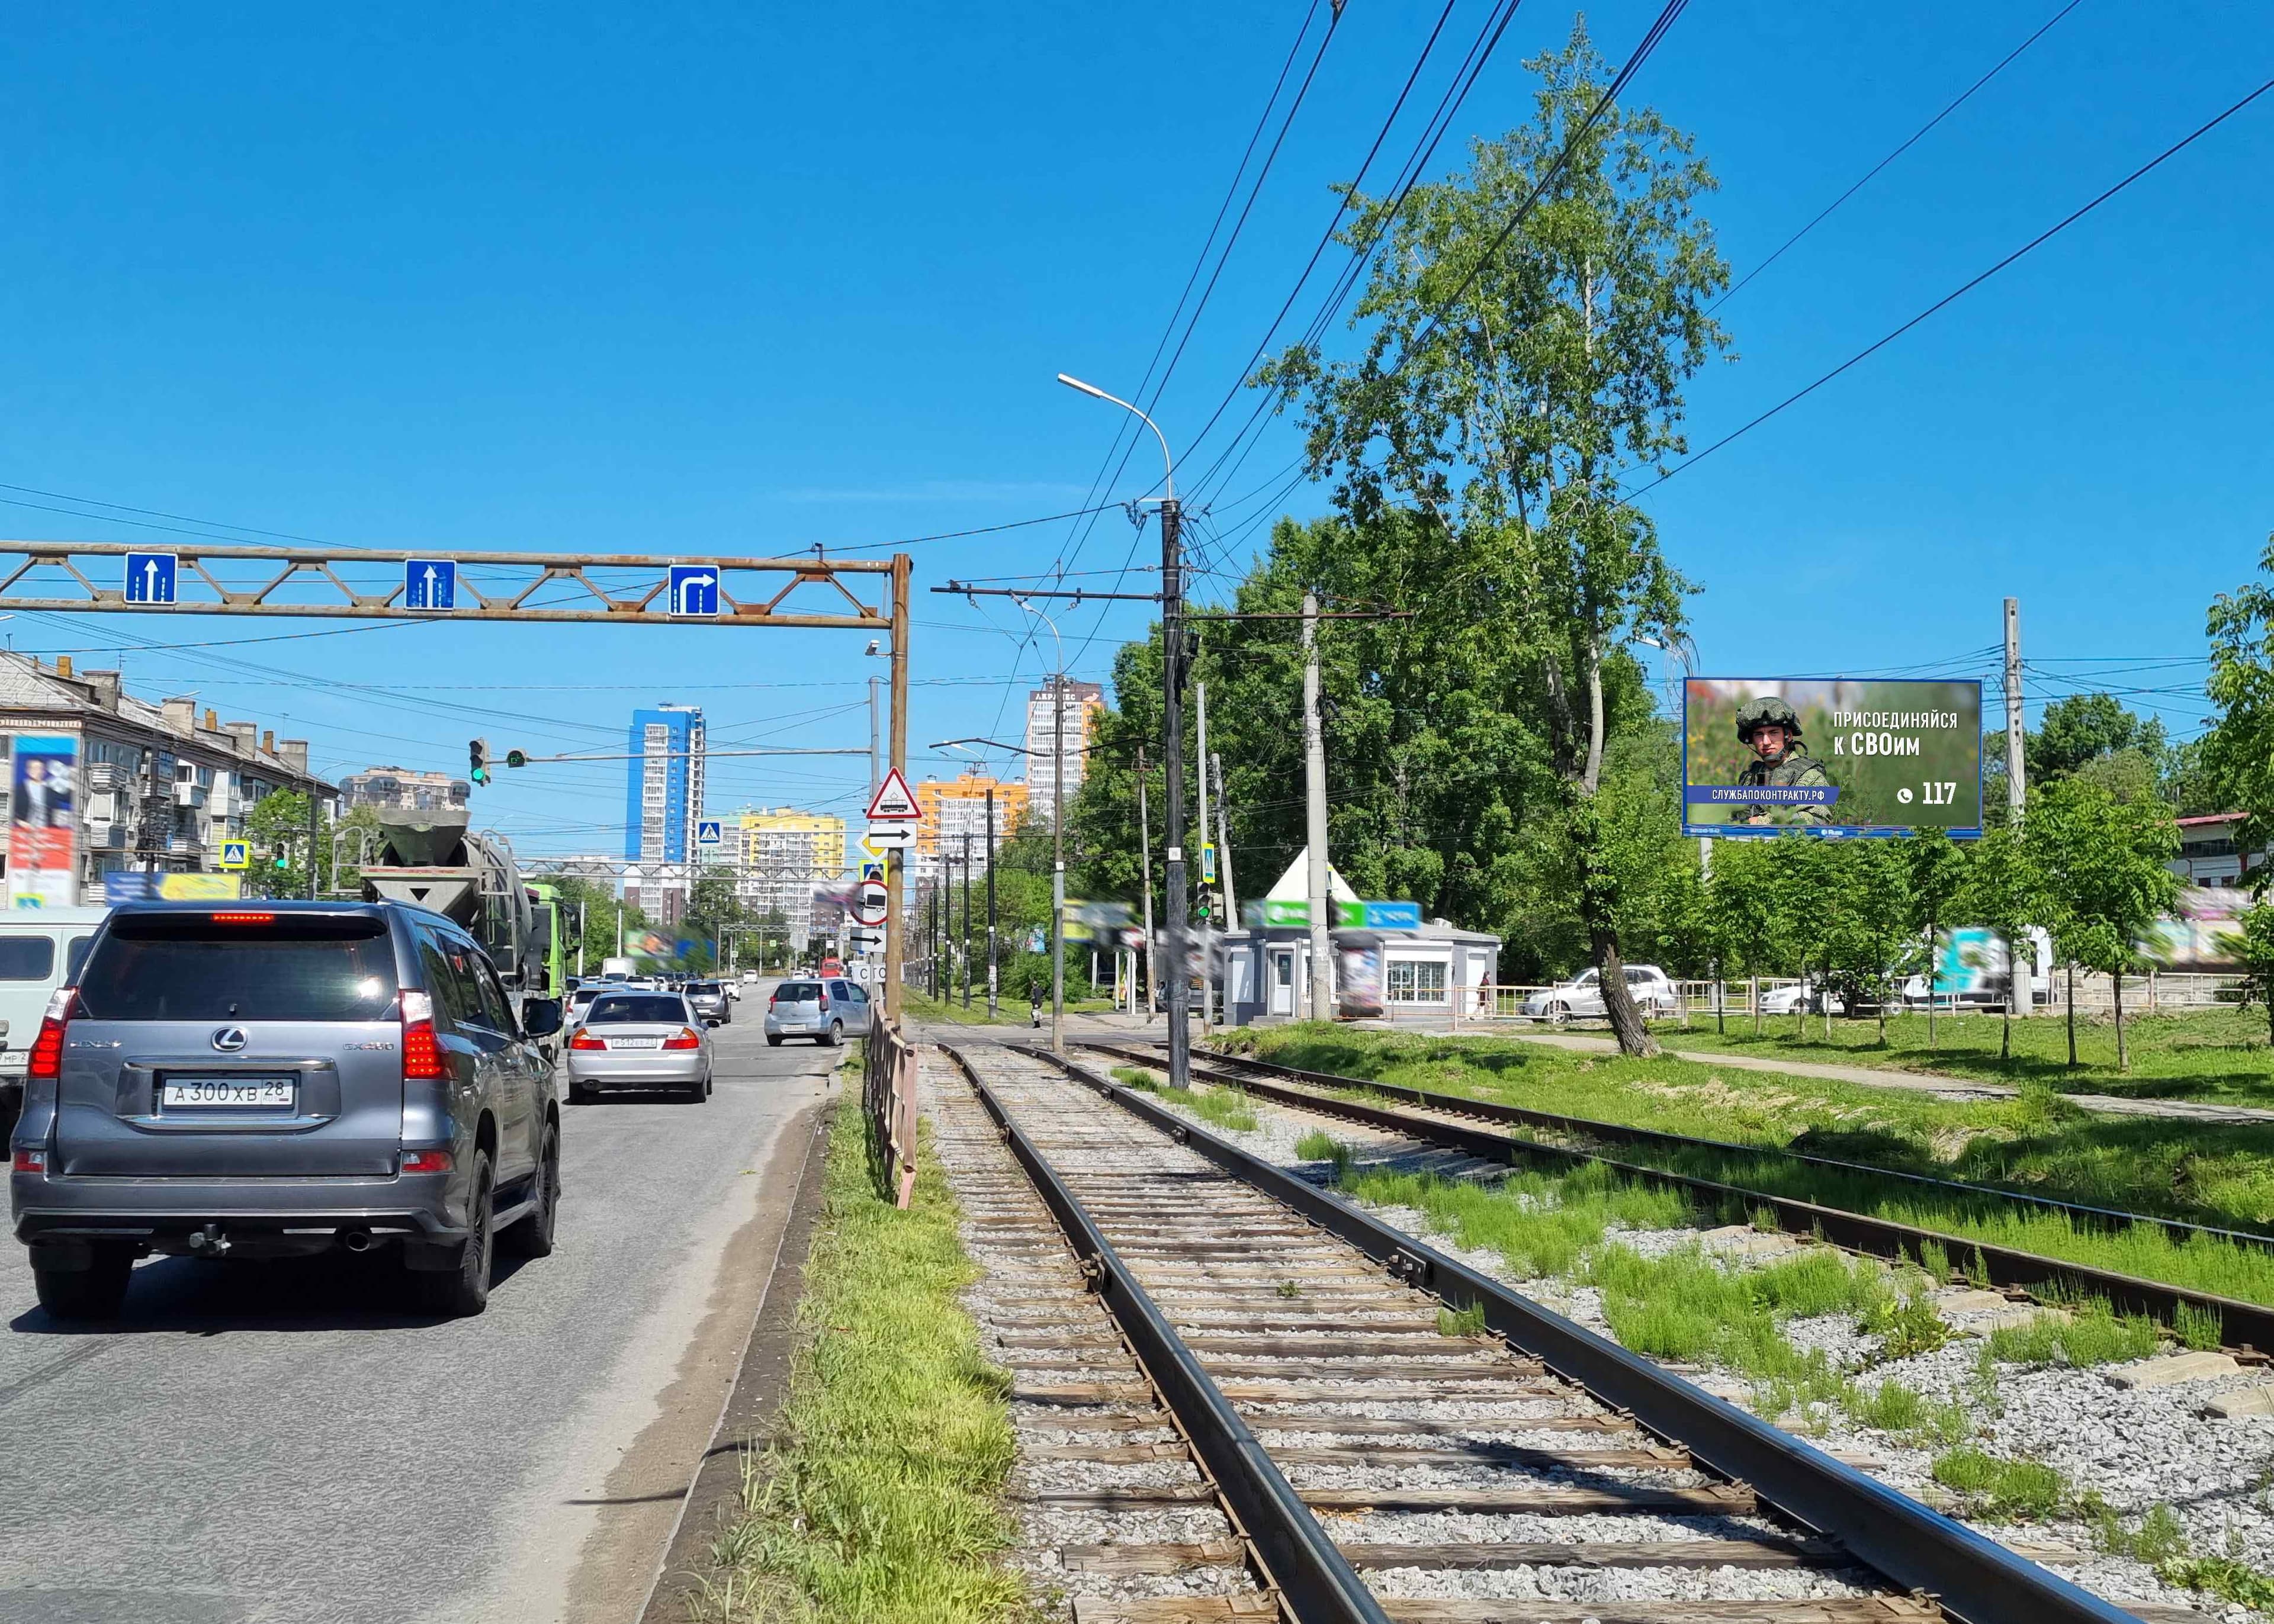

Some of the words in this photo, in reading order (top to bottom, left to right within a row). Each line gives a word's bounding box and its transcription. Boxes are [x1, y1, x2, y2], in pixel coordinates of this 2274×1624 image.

[1833, 709, 1957, 729] ПРИСОЕДИНЯЙСЯ
[1712, 789, 1825, 800] СЛУЖБАПОКОНТРАКТУ.РФ
[1922, 782, 1957, 804] 117
[860, 967, 887, 979] СТО
[174, 1082, 258, 1101] А300ХВ
[264, 1082, 284, 1095] 28
